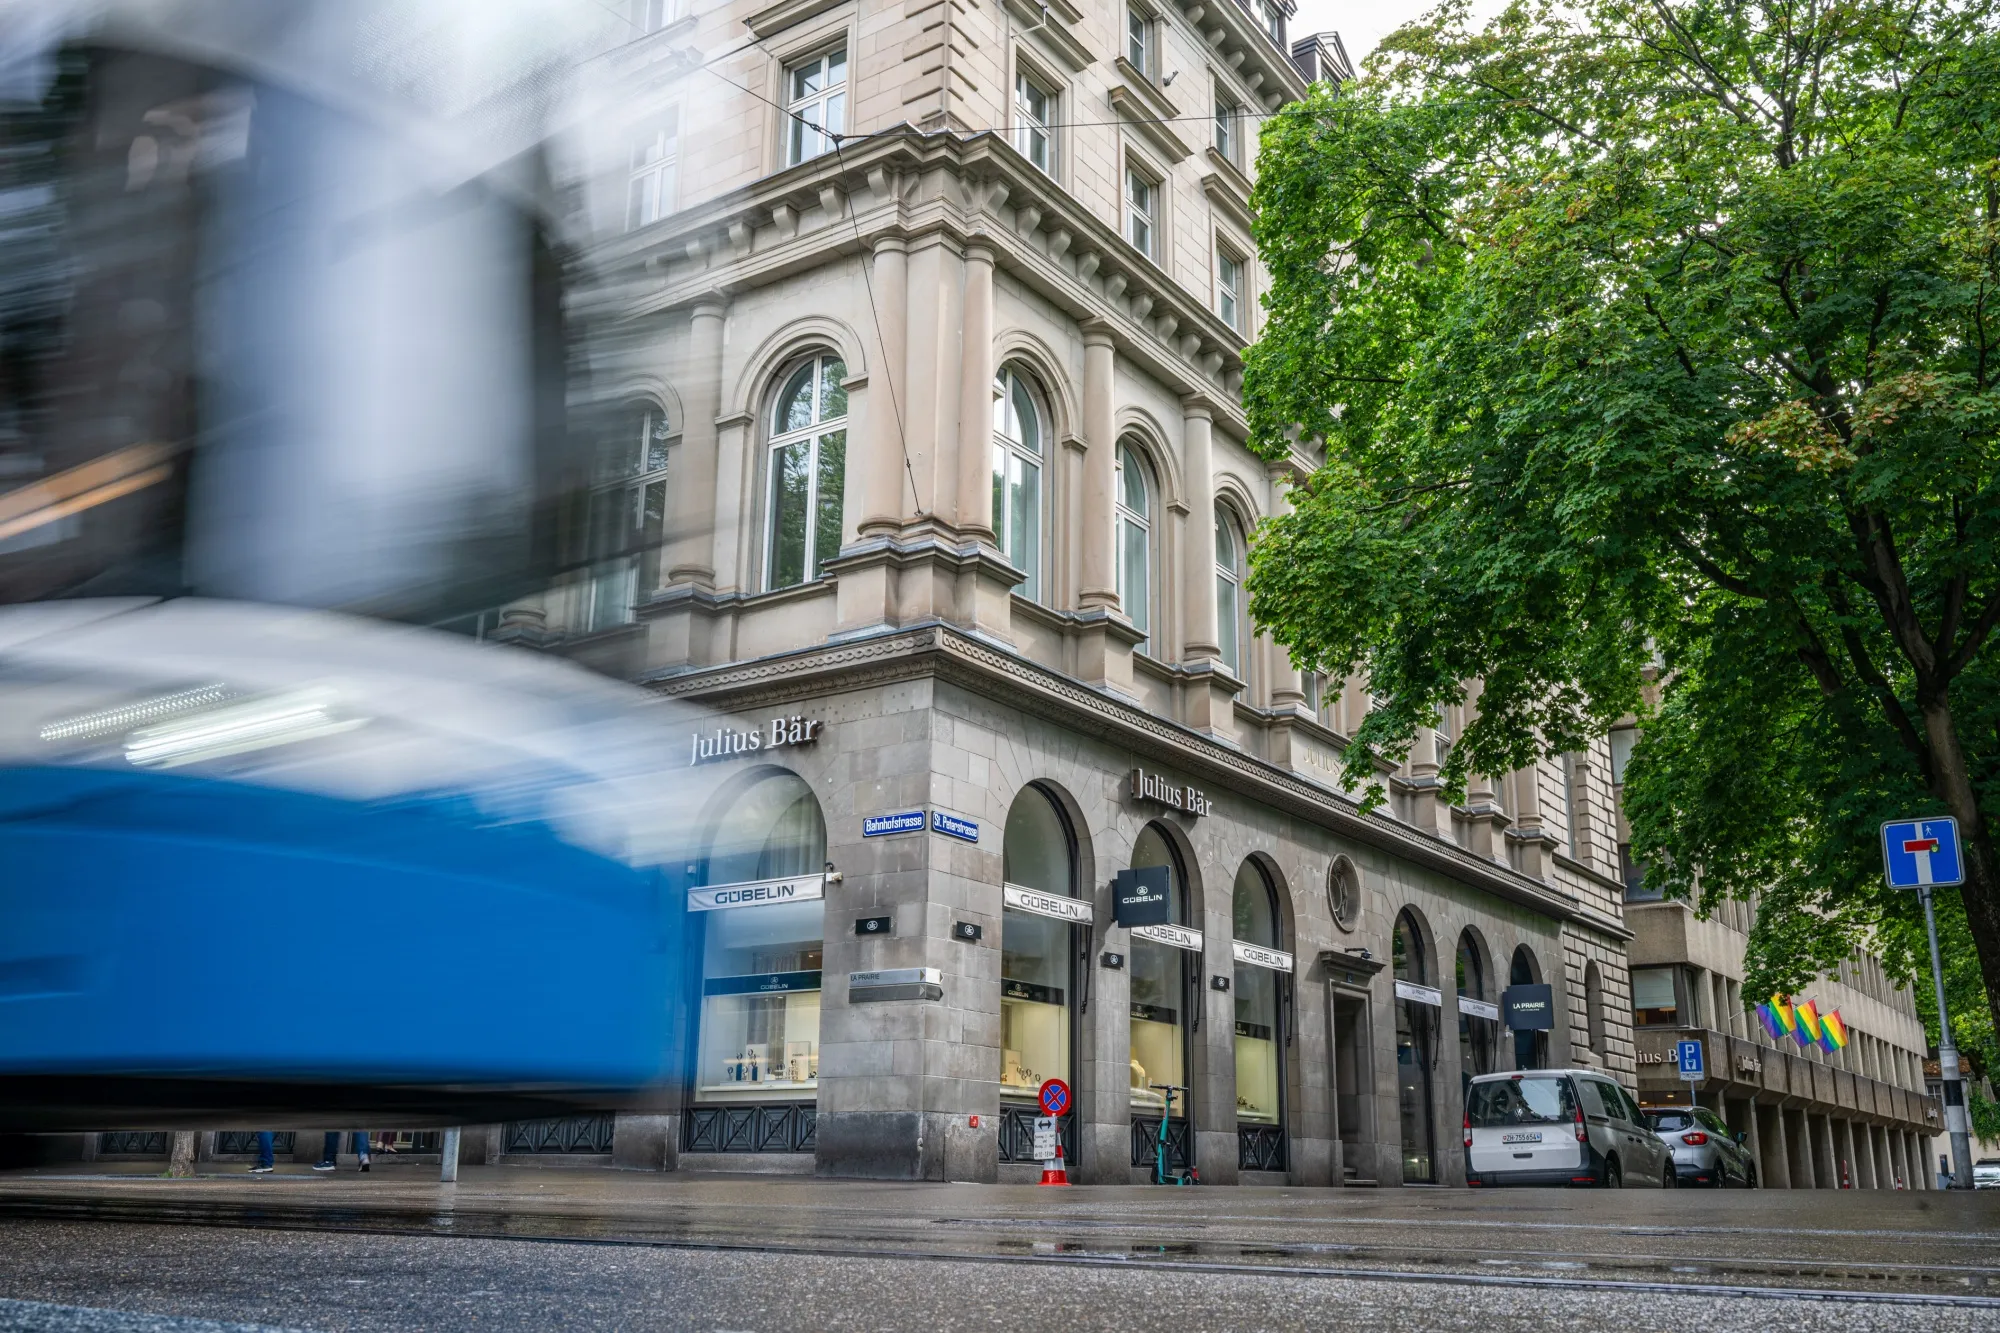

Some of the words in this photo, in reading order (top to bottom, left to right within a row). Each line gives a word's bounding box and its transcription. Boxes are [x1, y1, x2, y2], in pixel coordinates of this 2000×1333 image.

[690, 728, 760, 766] Julius
[770, 715, 817, 746] Bär
[1138, 768, 1182, 807] Julius
[1186, 786, 1213, 817] Bär
[866, 816, 922, 832] Bahnhofstrasse
[934, 813, 942, 827] St.
[943, 815, 977, 837] Peterstrasse
[715, 885, 794, 904] GÜBELIN
[1122, 894, 1163, 904] GÜBELIN
[1021, 894, 1078, 917] GÜBELIN
[1144, 926, 1191, 945] GÜBELIN
[1634, 1050, 1662, 1063] lius
[1685, 1044, 1695, 1059] P
